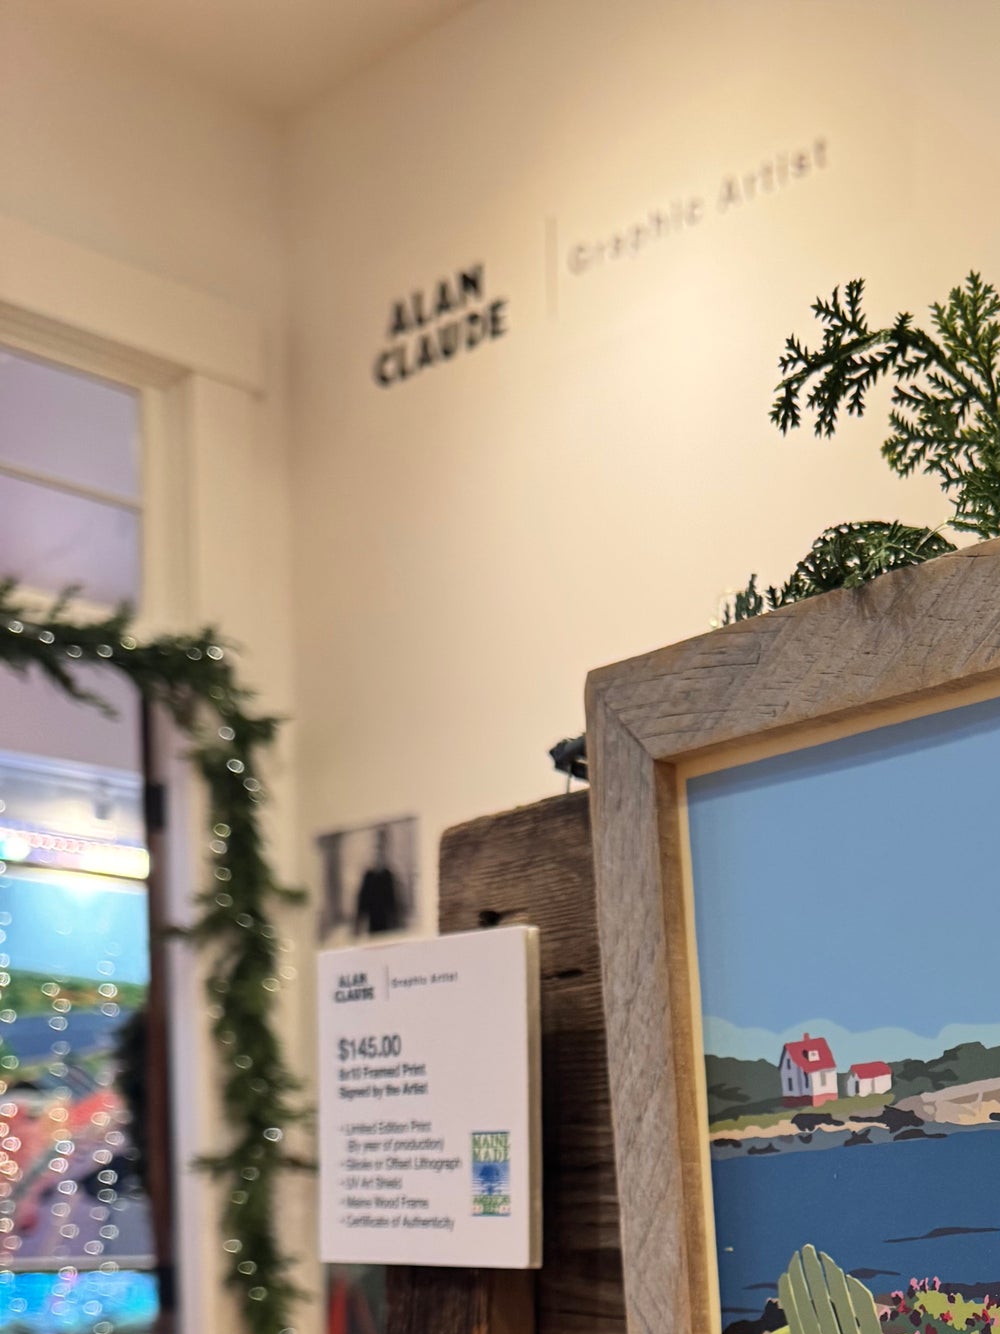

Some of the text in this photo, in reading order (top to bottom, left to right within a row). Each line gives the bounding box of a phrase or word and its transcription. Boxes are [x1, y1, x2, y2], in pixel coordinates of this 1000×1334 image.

[566, 135, 831, 275] Graphic Artist
[389, 263, 485, 336] ALAN
[373, 299, 509, 387] CLAUDE
[337, 972, 368, 988] ALAN
[333, 986, 375, 1003] CLAUDE
[337, 1034, 402, 1062] $145.00
[363, 1064, 400, 1079] Framed
[402, 1062, 426, 1077] Print
[338, 1081, 429, 1101] Signed by the Artist
[411, 1120, 432, 1133] Print
[414, 1157, 462, 1174] Lithograph
[401, 1196, 430, 1210] Frame
[402, 1215, 455, 1232] Authenticity
